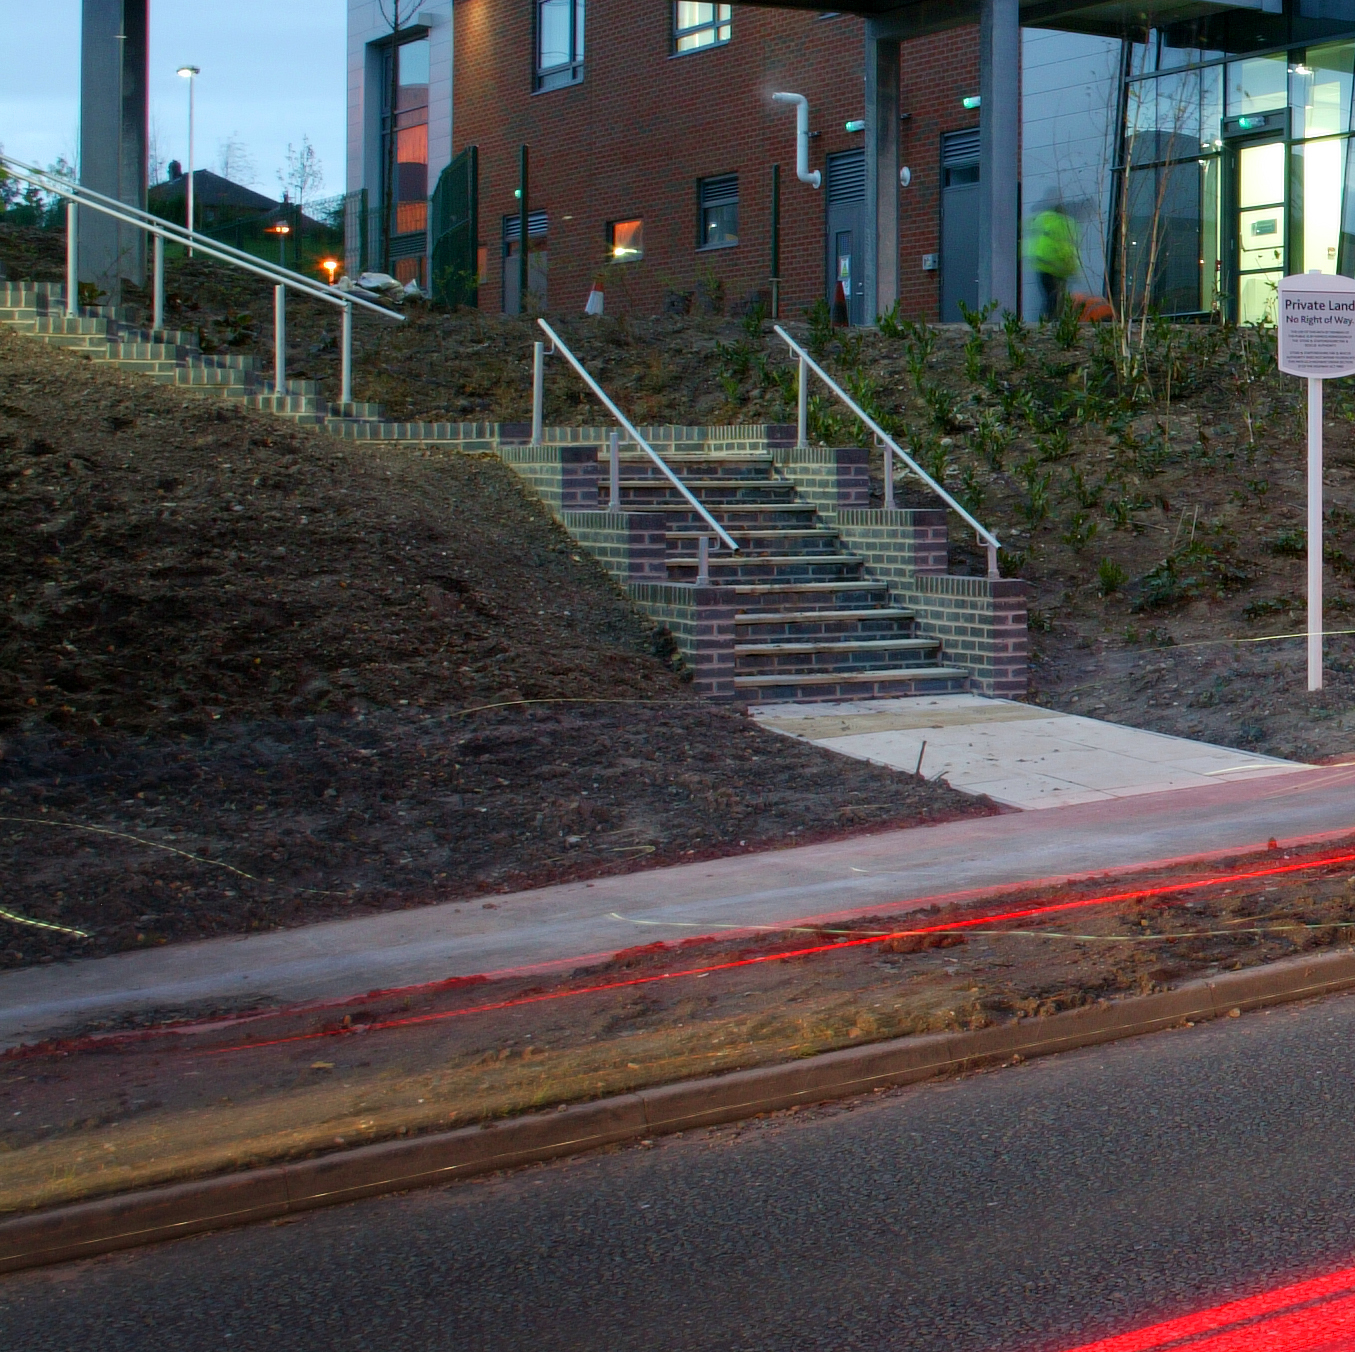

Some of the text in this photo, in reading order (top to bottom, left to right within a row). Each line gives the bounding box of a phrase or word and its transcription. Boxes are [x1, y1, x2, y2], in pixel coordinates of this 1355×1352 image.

[1285, 299, 1355, 311] Private Land
[1286, 315, 1299, 323] No
[1300, 315, 1322, 326] Right
[1324, 315, 1332, 323] of
